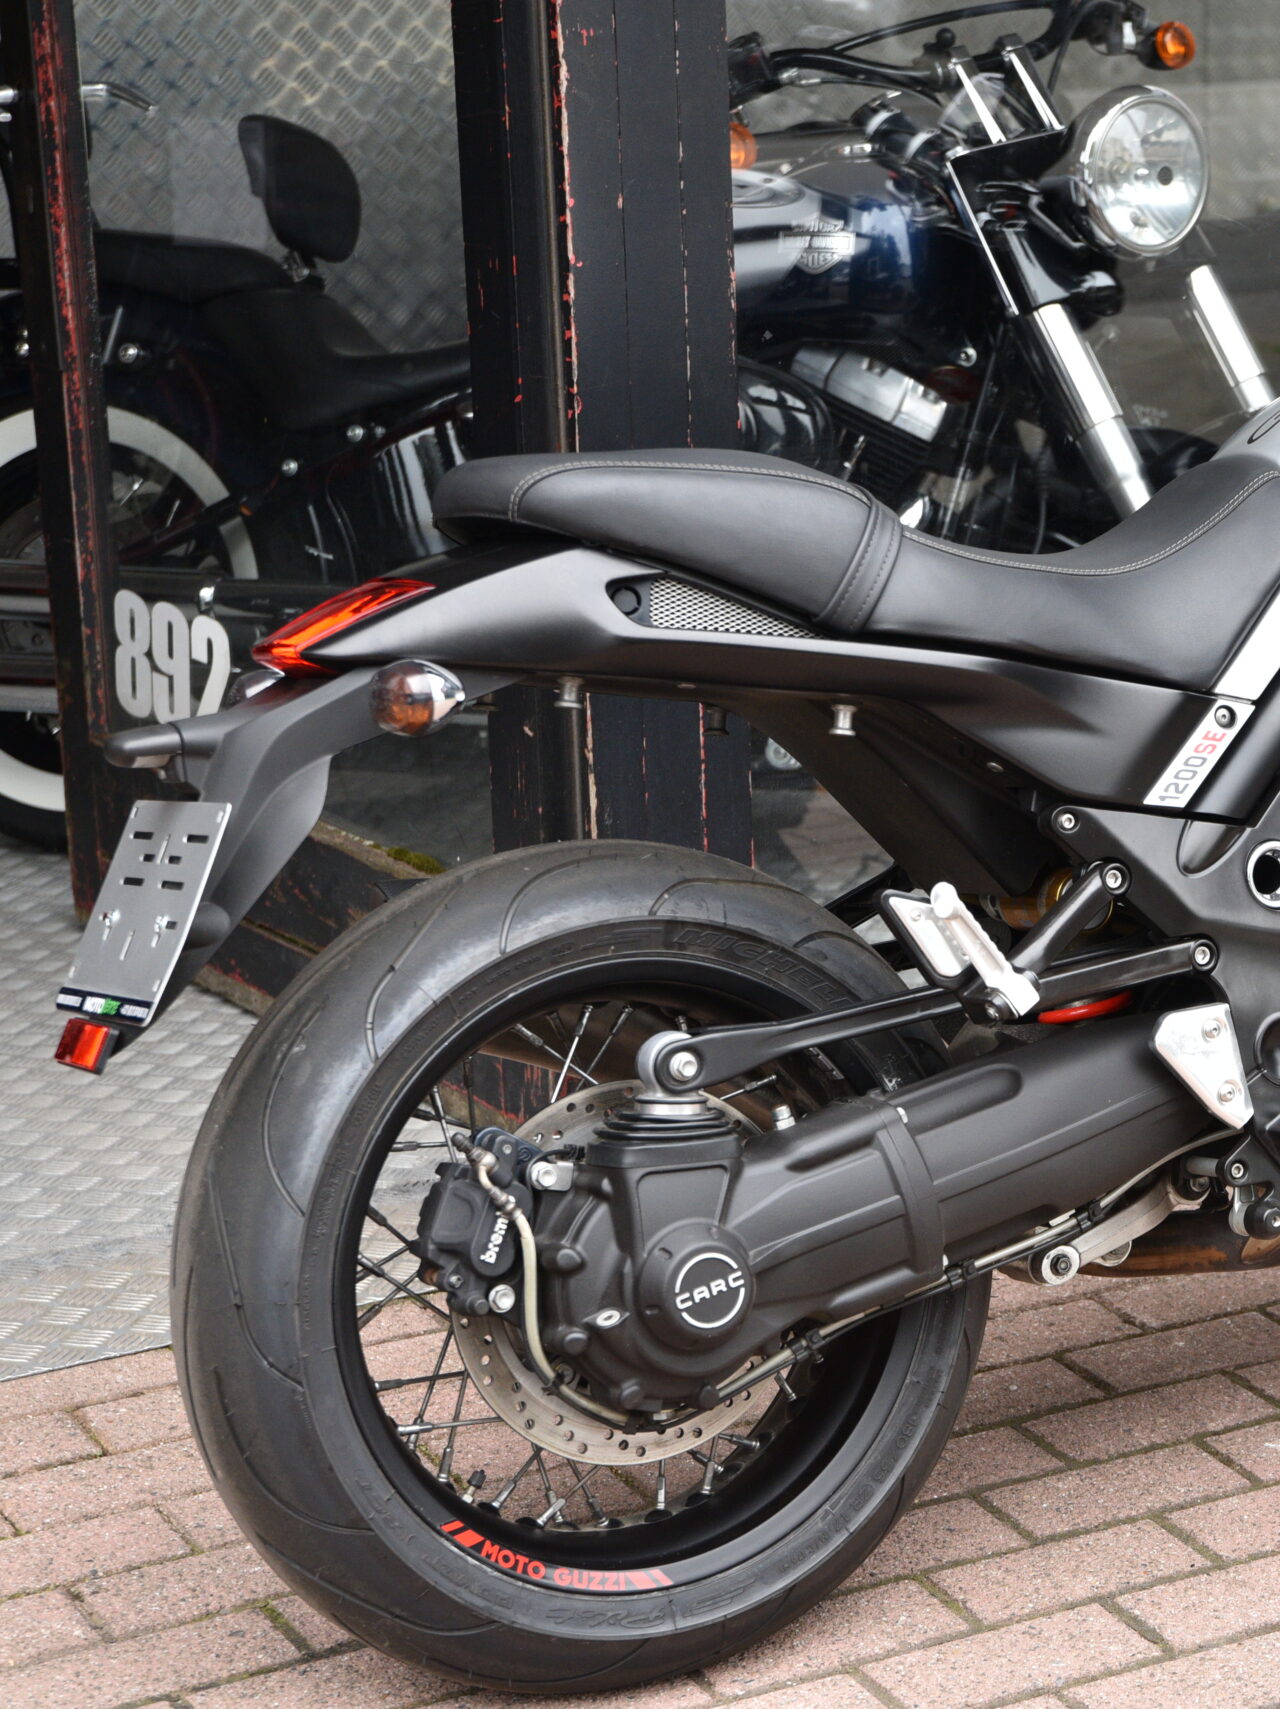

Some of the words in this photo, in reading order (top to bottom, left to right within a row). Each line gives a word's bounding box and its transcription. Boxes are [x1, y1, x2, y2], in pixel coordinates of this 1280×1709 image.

[114, 589, 231, 724] 892
[1158, 730, 1227, 802] 1200SE
[672, 928, 852, 1008] MICHEL
[480, 1211, 509, 1264] brem
[675, 1271, 744, 1310] CARC
[480, 1539, 546, 1580] MOTO
[553, 1567, 626, 1591] GUZZI
